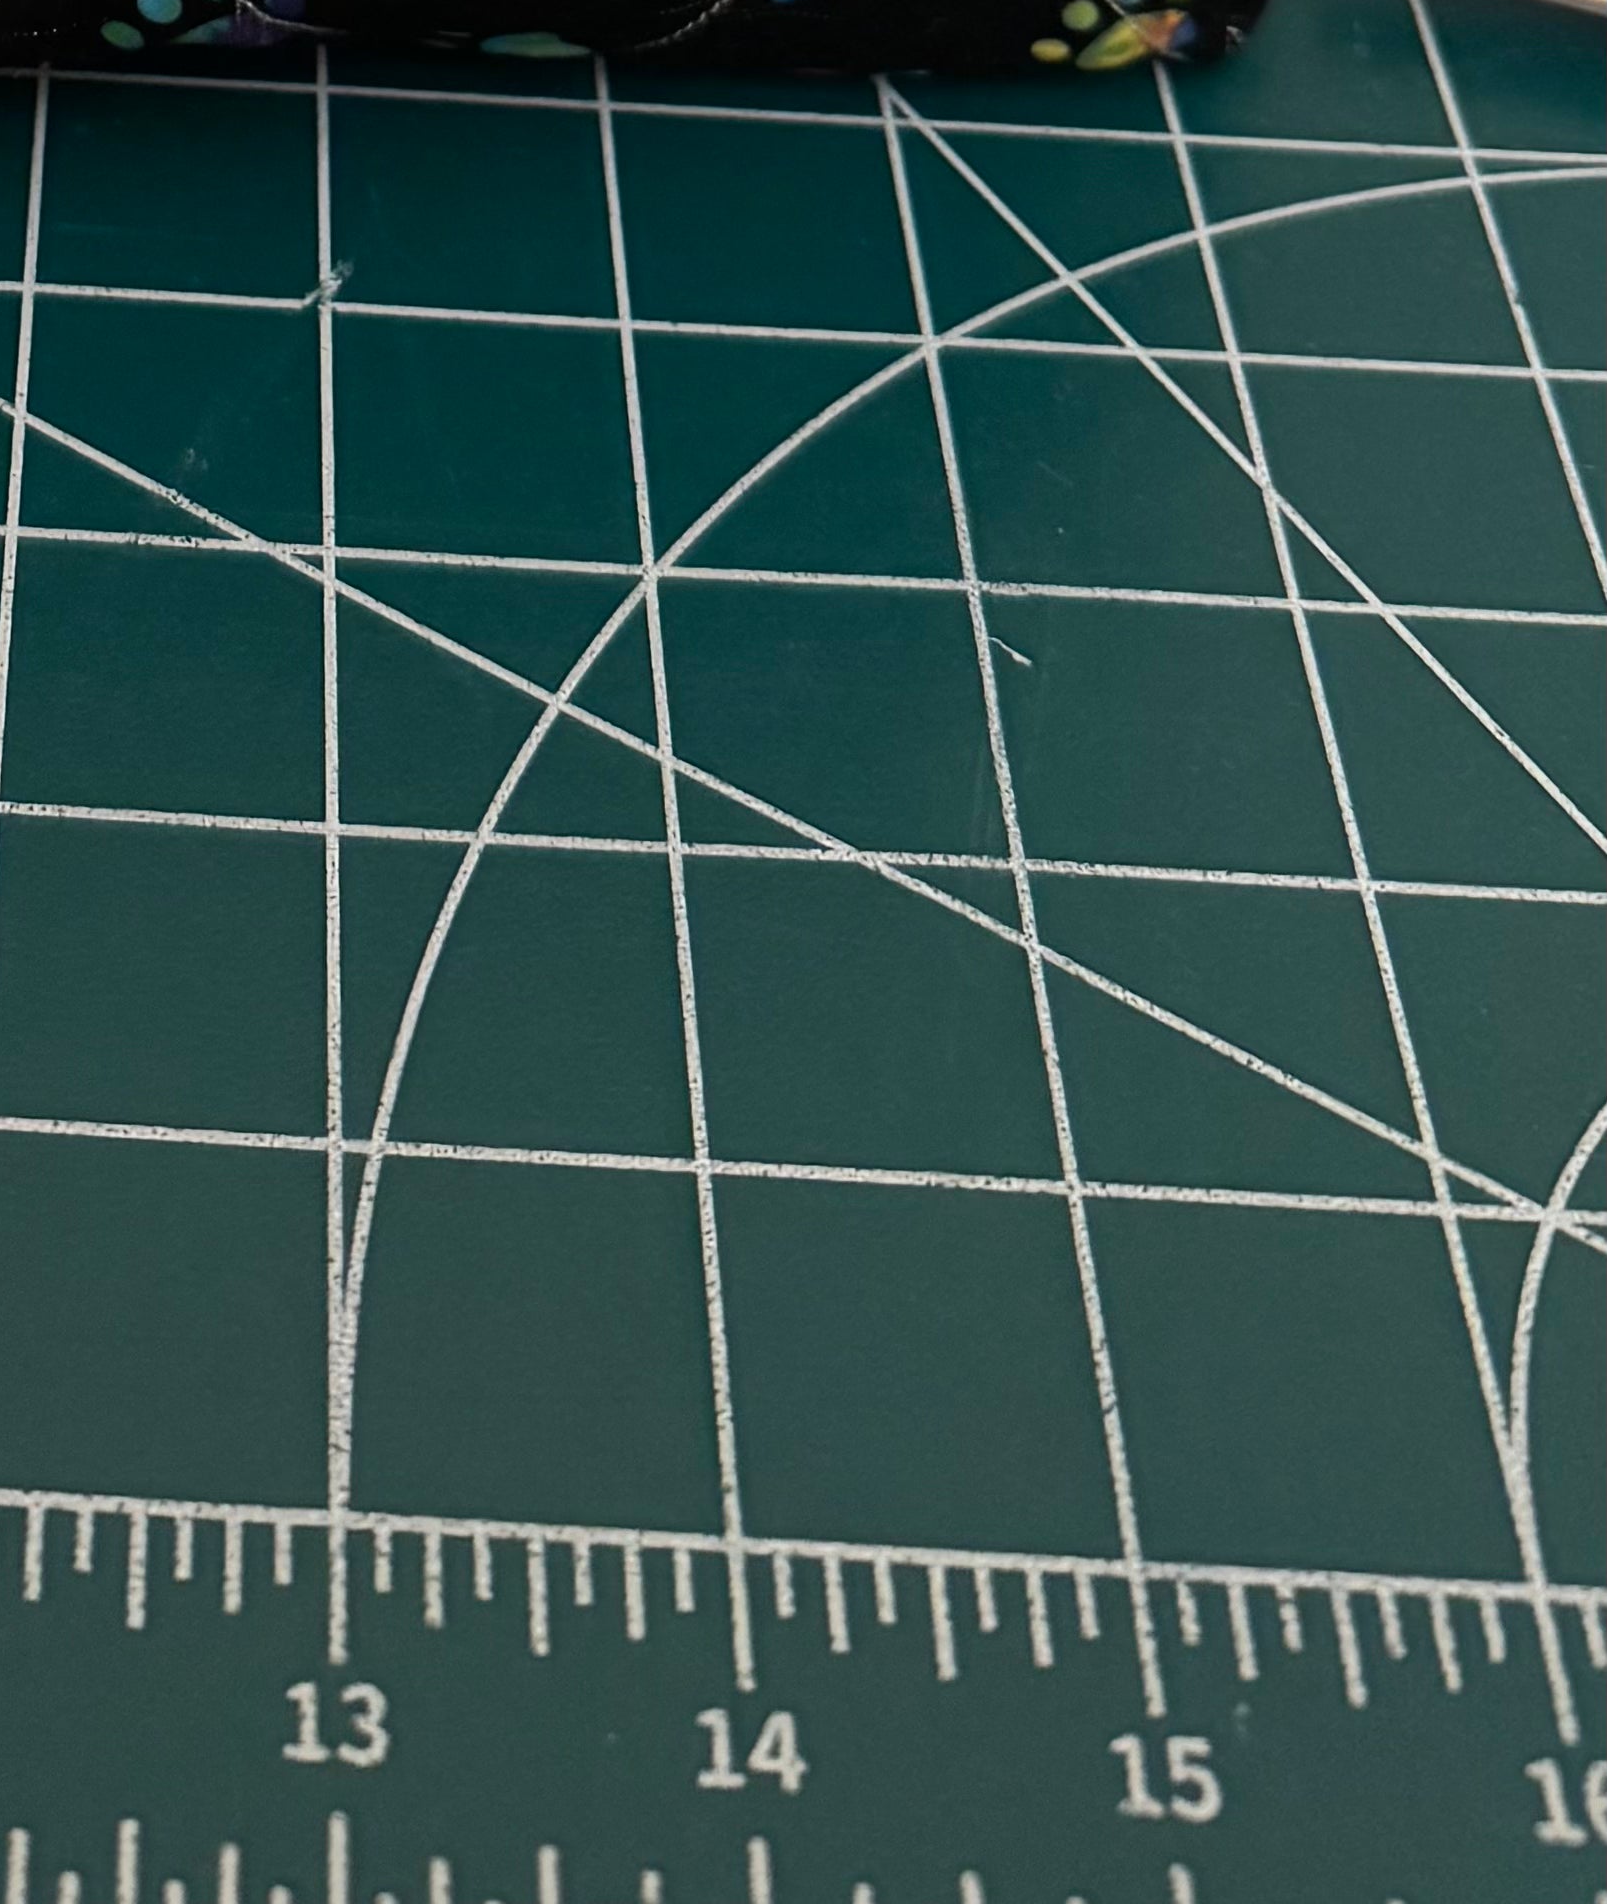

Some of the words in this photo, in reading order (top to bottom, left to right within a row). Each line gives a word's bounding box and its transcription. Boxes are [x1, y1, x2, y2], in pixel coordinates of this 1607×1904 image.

[280, 1680, 392, 1769] 13
[694, 1707, 809, 1793] 14
[1107, 1733, 1223, 1823] 15
